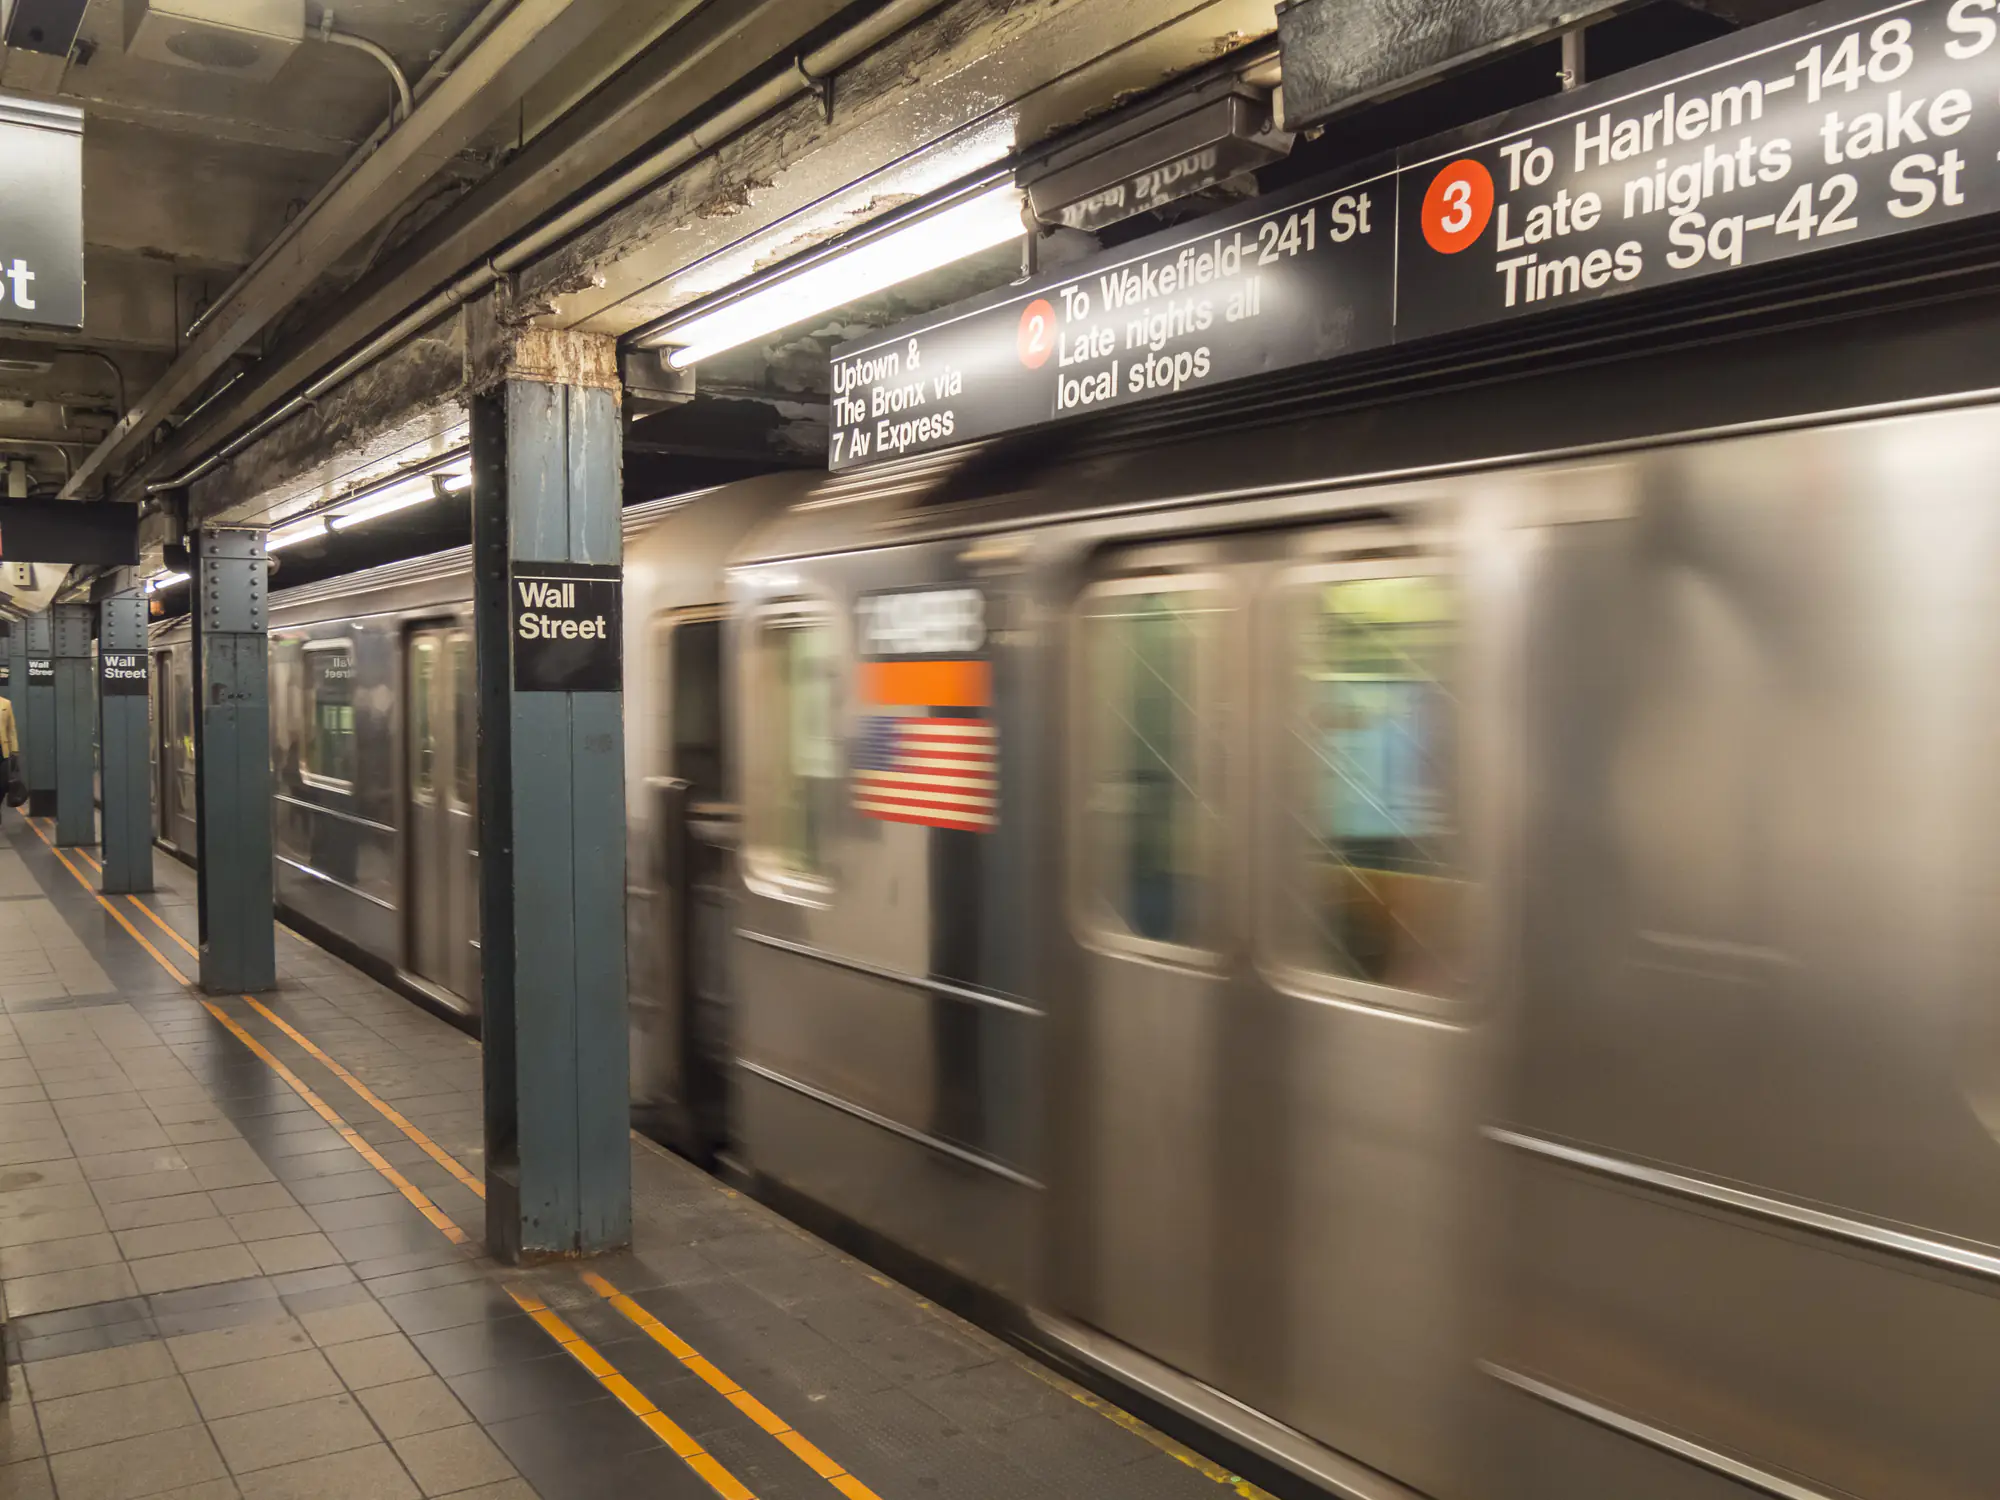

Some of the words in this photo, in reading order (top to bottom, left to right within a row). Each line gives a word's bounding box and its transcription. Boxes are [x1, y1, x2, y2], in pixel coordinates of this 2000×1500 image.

[1500, 138, 1554, 192] To
[1574, 18, 1914, 173] Harlem-148
[1945, 0, 2000, 60] S
[1496, 190, 1601, 252] Late
[1623, 136, 1792, 219] nights
[1819, 88, 1973, 165] take
[1441, 180, 1472, 234] 3
[1495, 241, 1642, 308] Times
[1665, 173, 1858, 269] Sq-42
[1887, 149, 1965, 219] St
[0, 259, 36, 310] t
[1059, 287, 1090, 324] To
[1100, 209, 1316, 302] Wakefield-241
[1330, 191, 1371, 242] St
[1028, 315, 1046, 354] 2
[1059, 321, 1115, 368] Late
[1126, 299, 1213, 350] nights
[1226, 277, 1261, 323] all
[833, 349, 899, 397] Uptown
[906, 338, 921, 370] &
[1057, 363, 1118, 410] local
[1128, 344, 1211, 400] stops
[833, 393, 866, 429] The
[871, 379, 926, 419] Bronx
[934, 366, 962, 400] via
[833, 432, 845, 463] 7
[849, 426, 871, 458] Av
[877, 409, 954, 454] Express
[518, 582, 575, 608] Wall
[519, 612, 606, 640] Street
[104, 656, 135, 667] Wall
[104, 668, 147, 679] Street
